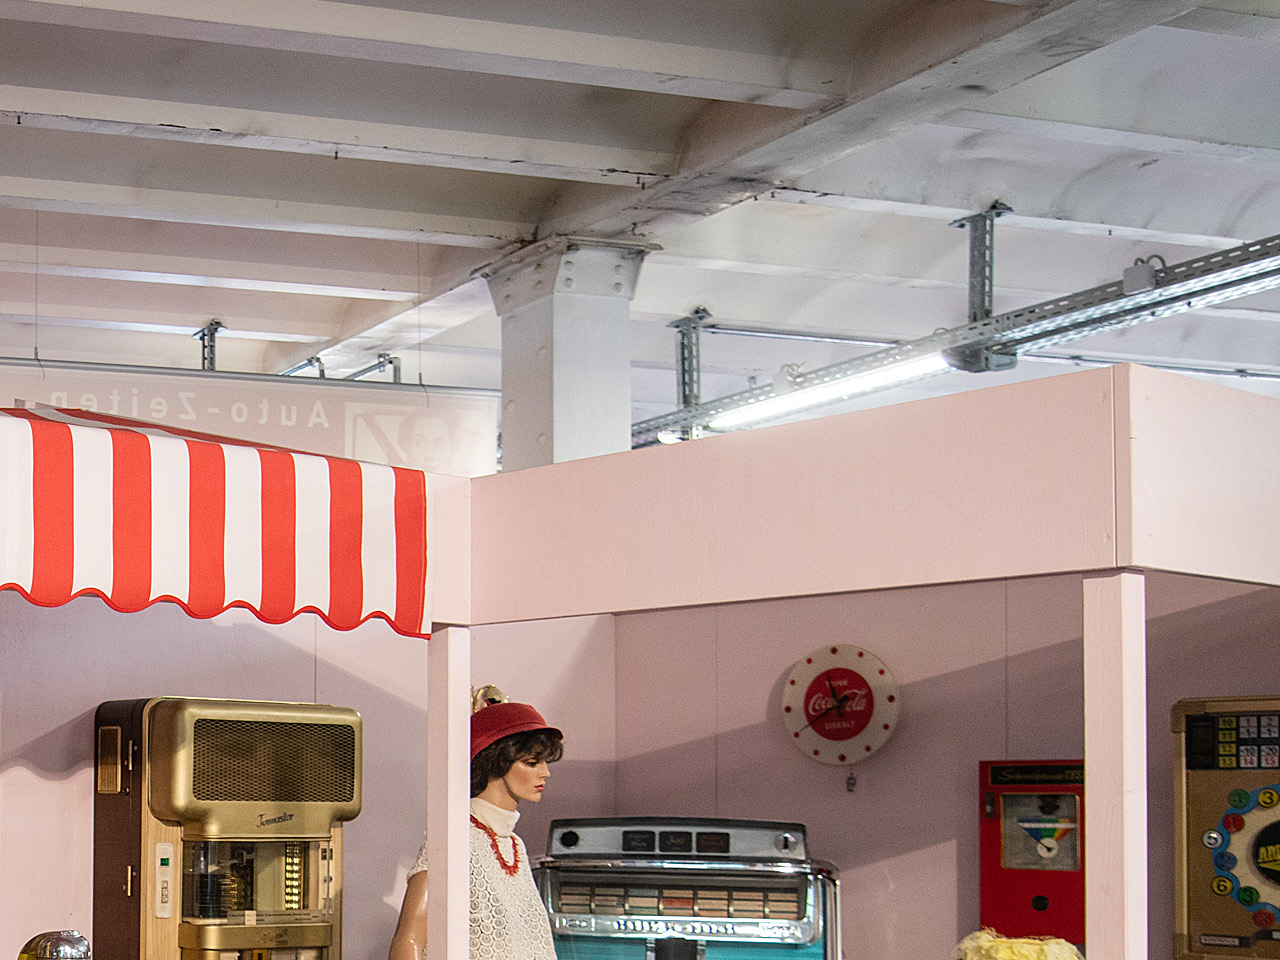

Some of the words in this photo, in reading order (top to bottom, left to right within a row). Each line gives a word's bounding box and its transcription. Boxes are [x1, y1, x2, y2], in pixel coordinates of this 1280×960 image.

[808, 688, 869, 717] Cocaola
[1263, 791, 1275, 805] 3
[1216, 878, 1228, 893] 6
